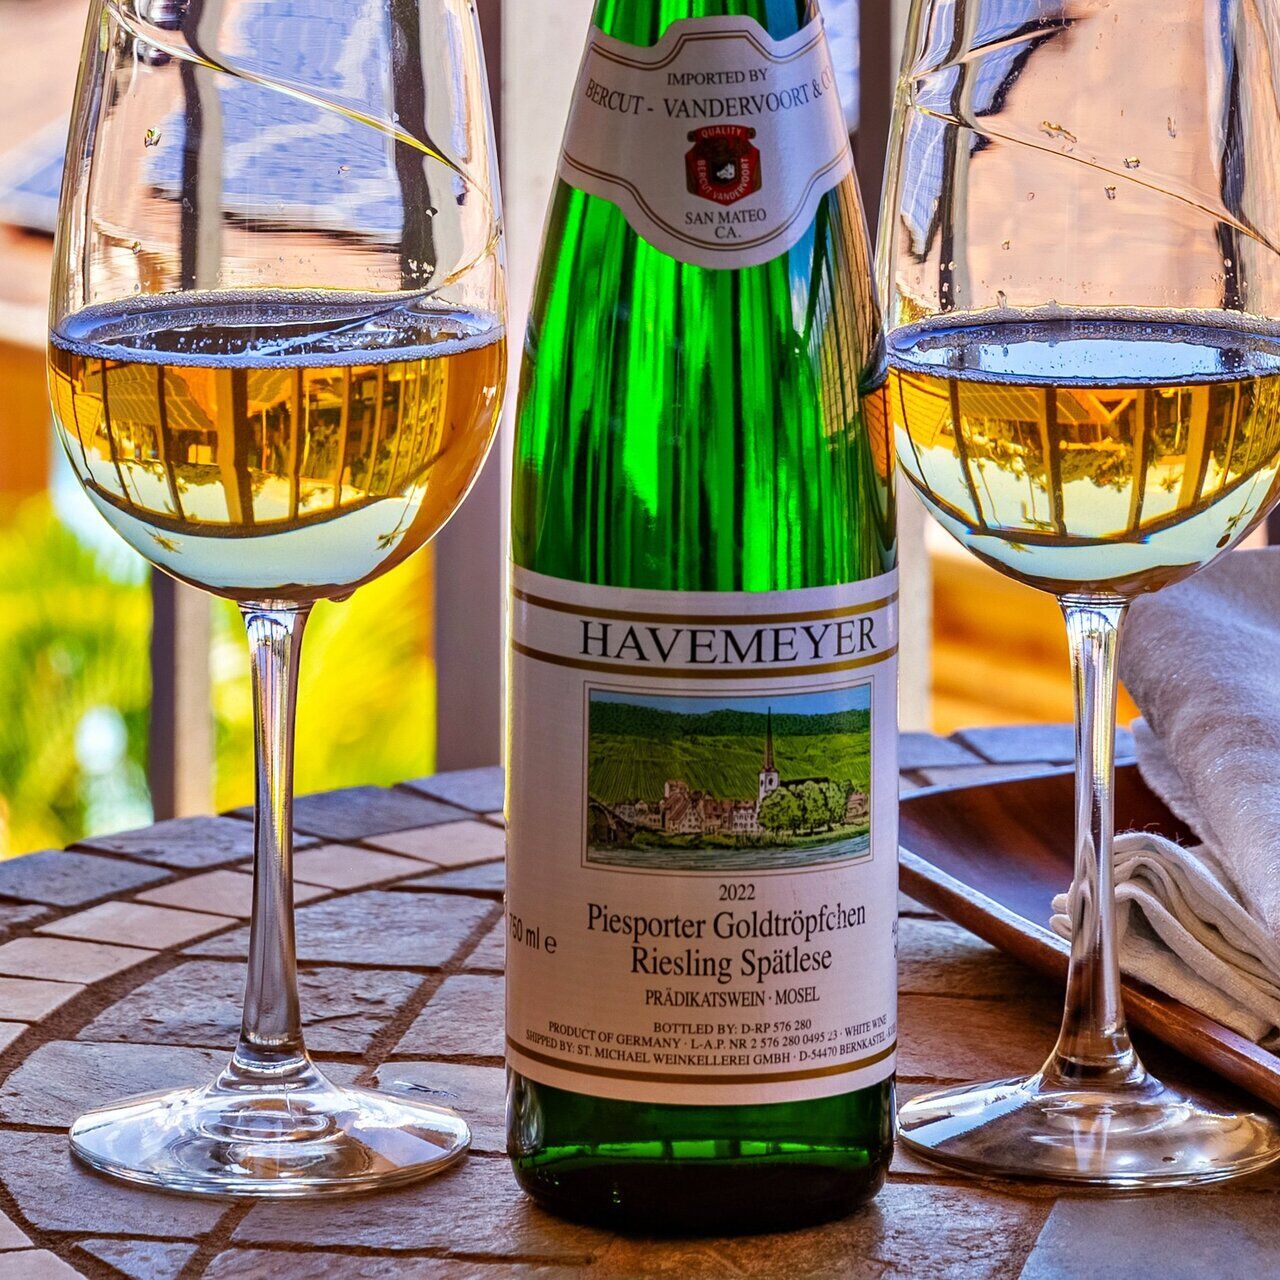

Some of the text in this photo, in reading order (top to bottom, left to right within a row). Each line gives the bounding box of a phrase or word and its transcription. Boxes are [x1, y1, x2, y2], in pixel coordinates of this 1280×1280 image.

[667, 68, 768, 86] IMPORTED BY
[585, 78, 644, 115] BERCUT
[664, 83, 810, 118] VANDERVOORT
[812, 78, 822, 98] &
[701, 126, 742, 138] QUALITY
[697, 158, 750, 201] BERCUT VANDERVOORT
[685, 208, 767, 225] SAN MATEO
[714, 225, 742, 239] CA.
[579, 616, 878, 665] HAVEMEYER
[718, 883, 756, 901] 2022
[586, 903, 706, 944] Piesporter
[713, 902, 866, 942] Goldtröpfchen
[525, 926, 540, 950] ml
[630, 945, 832, 985] Riesling Spätlese
[645, 986, 820, 1007] PRÄDIKATSWEIN MOSEL
[548, 1021, 596, 1041] PRODUCT
[598, 1031, 614, 1043] OF
[616, 1033, 681, 1049] GERMANY
[729, 1039, 747, 1049] NR
[750, 1038, 757, 1049] 2
[760, 1037, 779, 1049] 576
[782, 1035, 800, 1047] 280
[802, 1031, 825, 1045] 0495
[845, 1021, 871, 1037] WHITE
[872, 1014, 887, 1029] WINE
[653, 1019, 812, 1035] BOTTLED BY: D-RP 576 280
[526, 1029, 558, 1049] SHIPPED
[559, 1041, 575, 1054] BY:
[577, 1043, 592, 1056] ST.
[595, 1047, 651, 1063] MICHAEL
[653, 1053, 750, 1066] WEINKELLEREI
[753, 1052, 790, 1065] GMBH
[799, 1045, 837, 1062] D-54470
